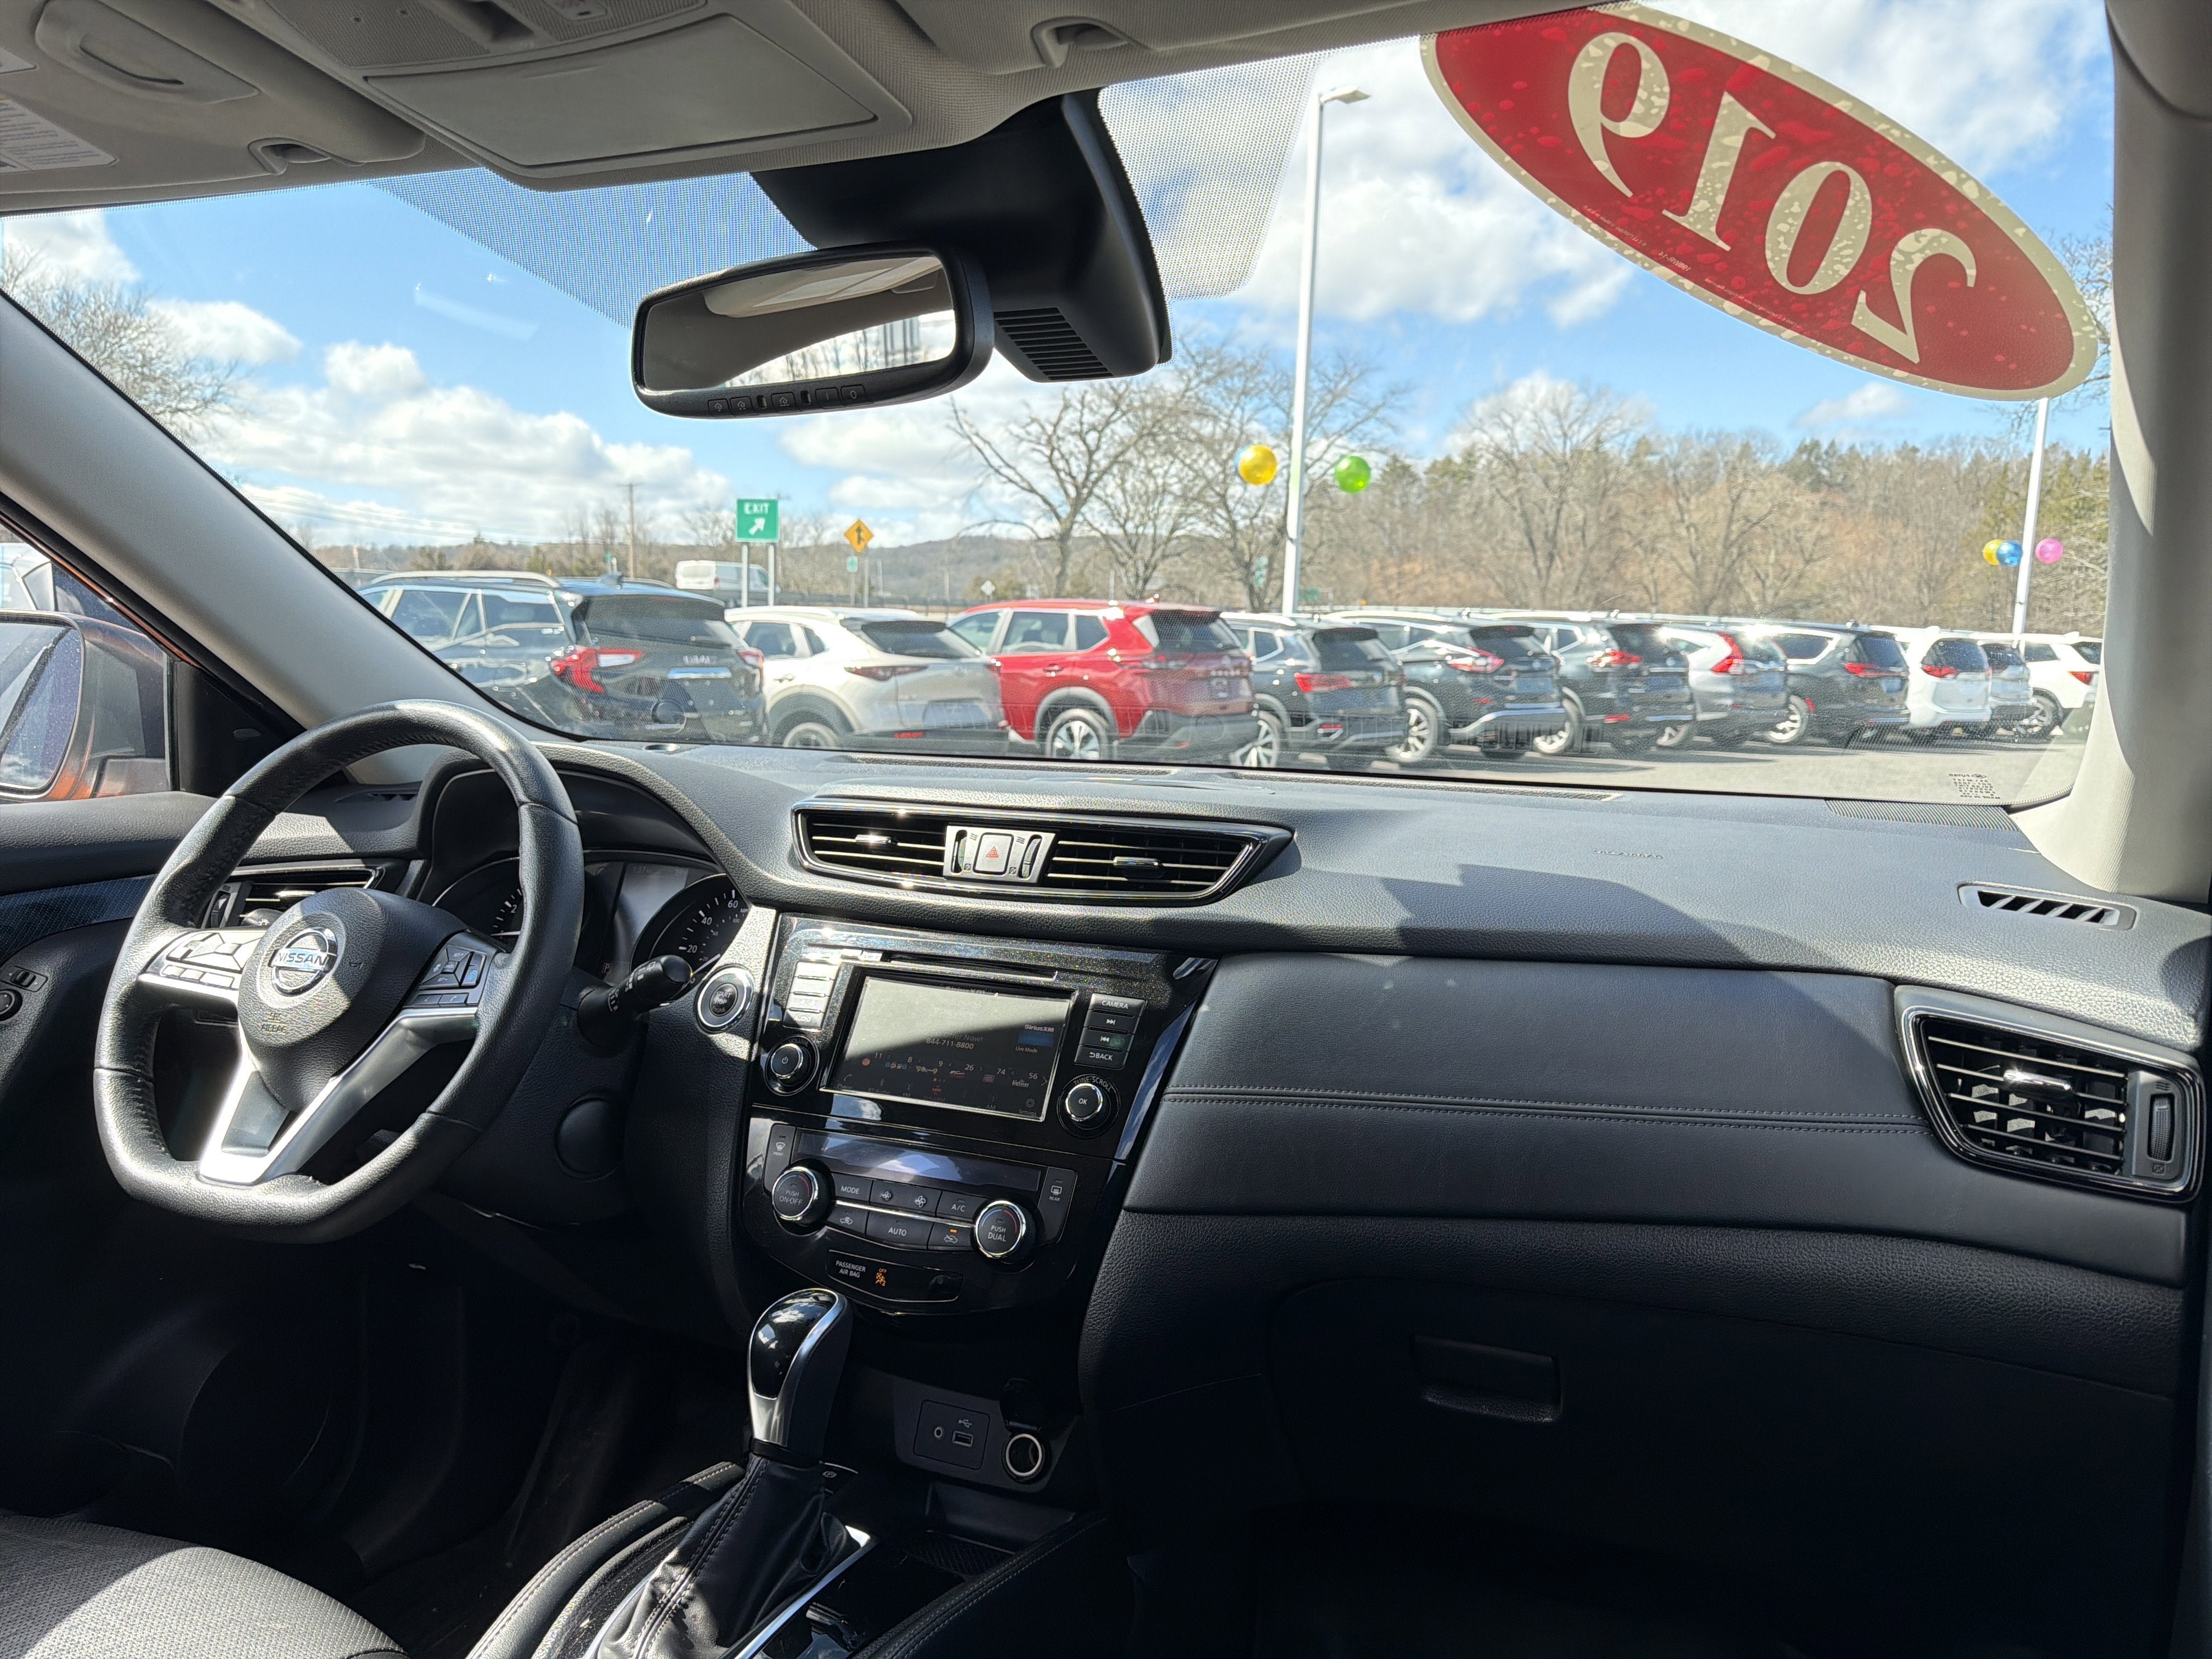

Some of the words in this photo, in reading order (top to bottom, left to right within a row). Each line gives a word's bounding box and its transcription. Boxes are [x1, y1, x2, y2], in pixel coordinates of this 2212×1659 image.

[743, 502, 770, 515] EXIT
[511, 904, 517, 913] 2
[728, 900, 738, 909] 60
[701, 917, 712, 926] 40
[687, 944, 698, 953] 20
[275, 952, 328, 966] NISSAN
[1102, 1000, 1128, 1009] CAMERA
[1024, 1024, 1054, 1032] SiriusXM
[963, 1034, 983, 1042] Now!
[926, 1037, 974, 1049] 844-711-8800
[1095, 1052, 1113, 1060] BACK
[1018, 1108, 1037, 1117] Settings
[840, 1186, 860, 1194] MODE
[779, 1195, 803, 1205] ON-OFF
[951, 1204, 966, 1212] A/C
[888, 1227, 907, 1237] AUTO
[991, 1224, 1006, 1233] PUSH
[988, 1232, 1007, 1242] DUAL
[836, 1260, 866, 1272] PASSENGER
[849, 1270, 860, 1278] BAG
